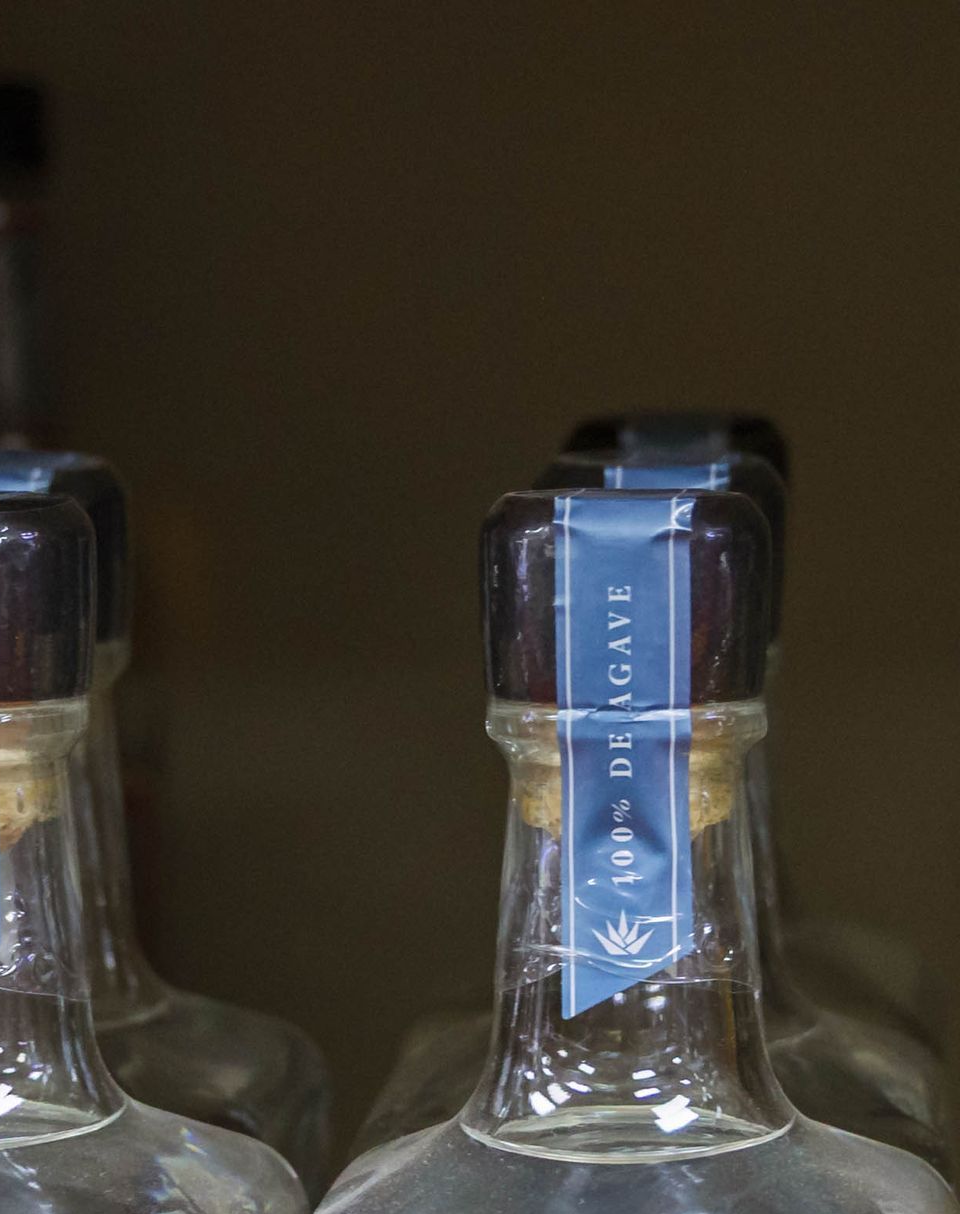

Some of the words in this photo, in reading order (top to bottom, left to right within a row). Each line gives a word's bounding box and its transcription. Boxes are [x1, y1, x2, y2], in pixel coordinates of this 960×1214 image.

[607, 584, 632, 712] AGAVE
[609, 732, 633, 779] DE
[610, 797, 635, 886] 100%
